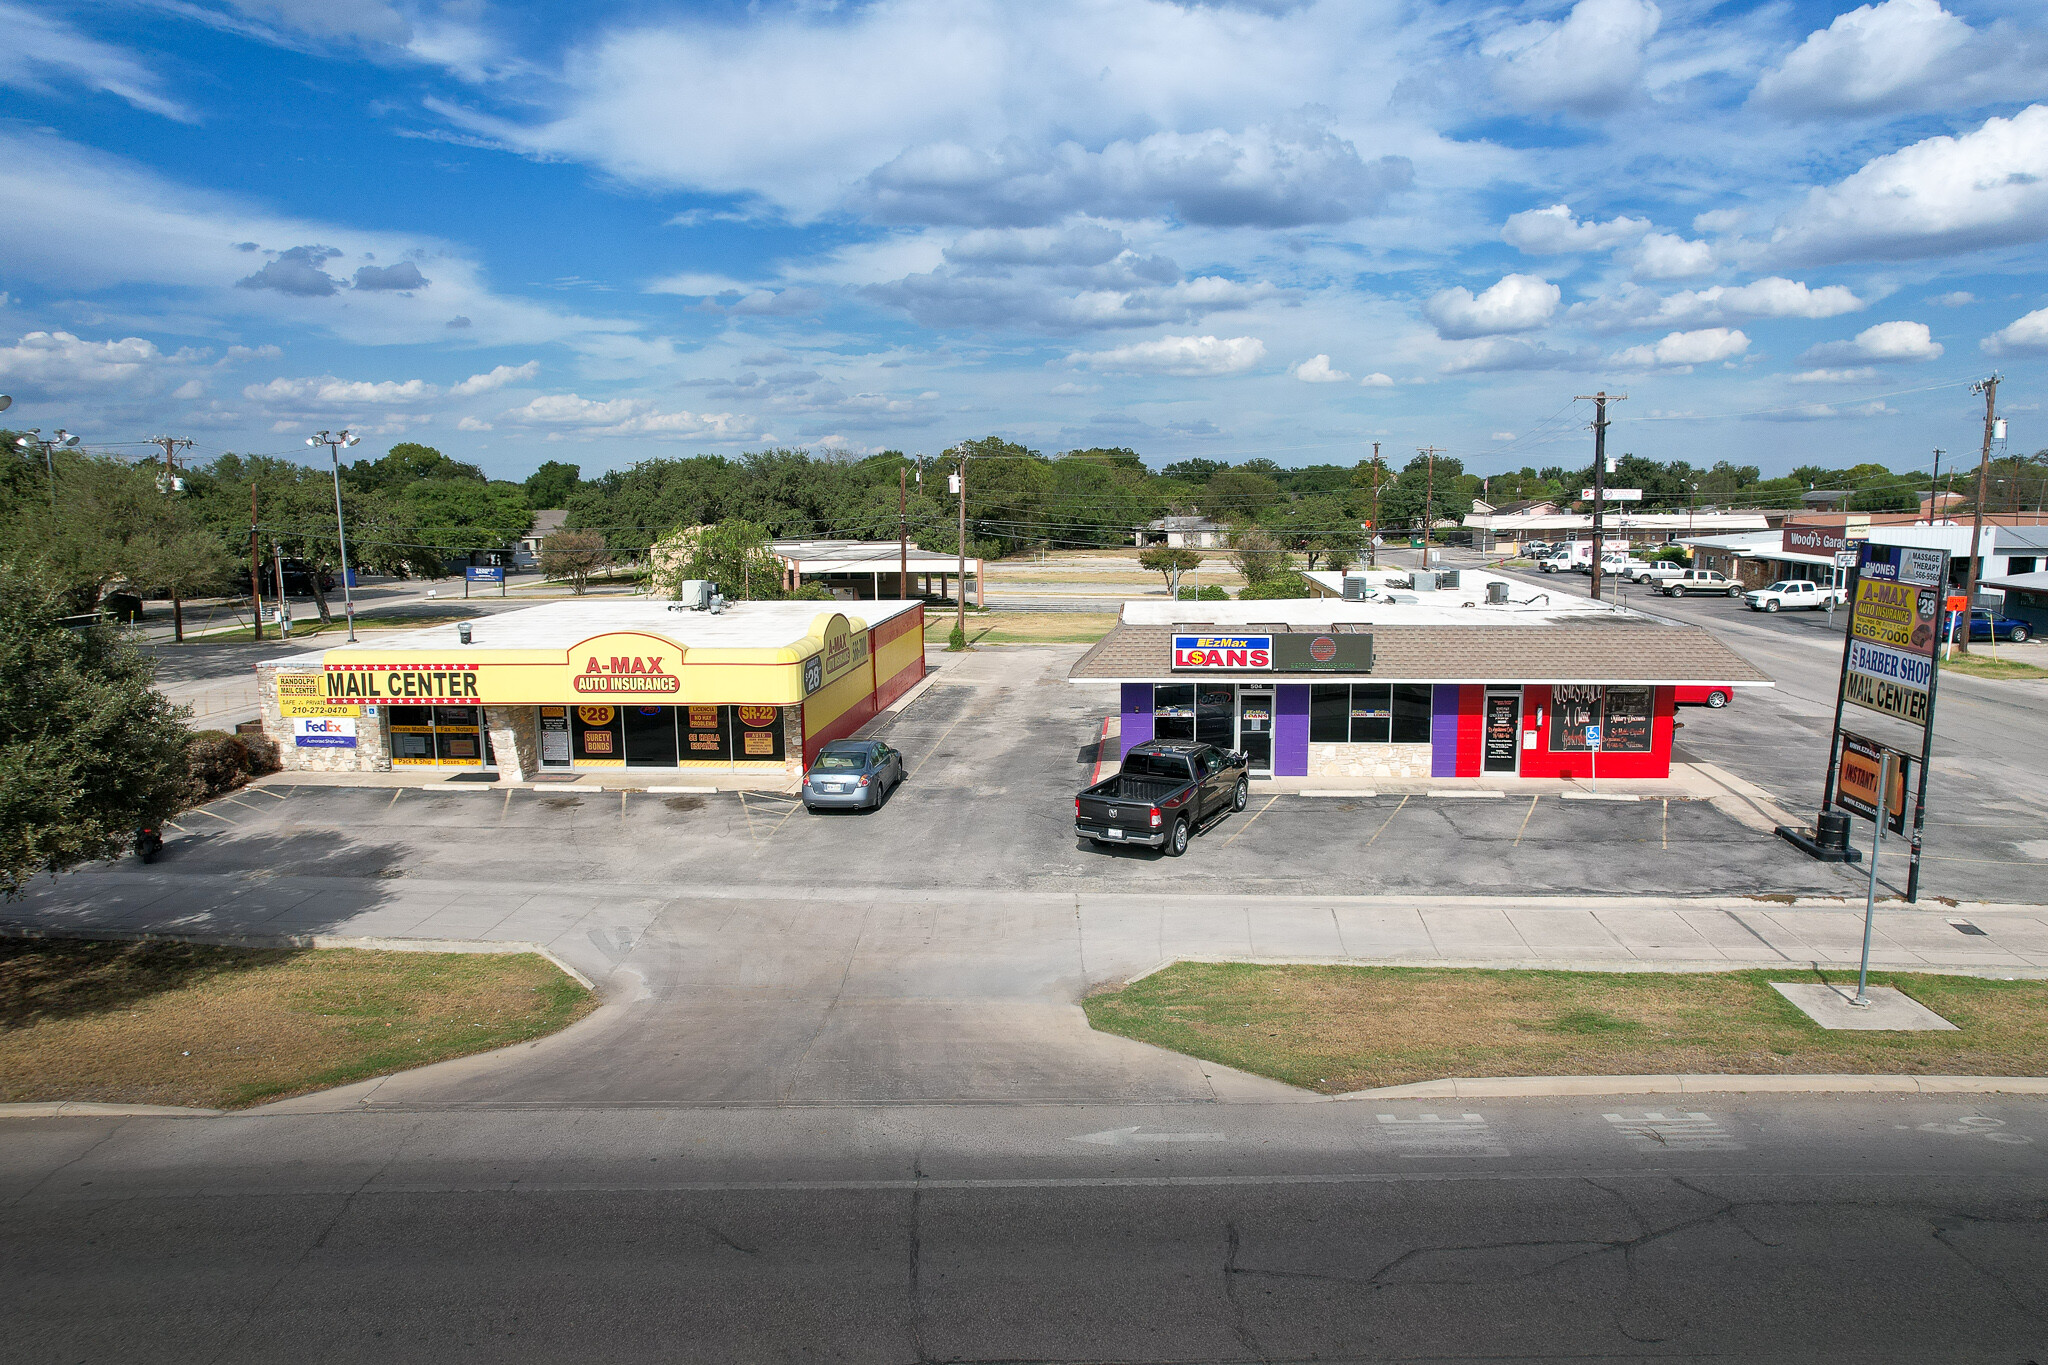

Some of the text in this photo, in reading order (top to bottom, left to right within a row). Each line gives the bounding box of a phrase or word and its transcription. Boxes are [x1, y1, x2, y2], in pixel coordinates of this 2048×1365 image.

[1791, 531, 1821, 548] Woody's
[1823, 536, 1846, 551] Garag
[1913, 552, 1940, 562] MASSAGE
[1865, 562, 1896, 576] PHONES
[1914, 562, 1940, 572] THERAPY
[1863, 582, 1910, 607] A-MAX
[1858, 602, 1909, 623] AUTO INSURANCE
[1918, 598, 1935, 615] $28
[1855, 622, 1909, 644] 566-7000
[586, 656, 664, 674] A-MAX
[1859, 647, 1930, 685] BARBER SHOP
[327, 673, 478, 697] MAIL CENTER
[578, 677, 676, 690] AUTO INSURANCE
[1201, 694, 1228, 704] OPEN
[1847, 672, 1927, 721] MAIL CENTER
[292, 706, 348, 714] 210-272-0470
[581, 706, 609, 721] $28
[741, 707, 774, 720] SR-22
[306, 720, 342, 732] FedEx
[586, 733, 610, 742] SURETY
[689, 733, 721, 742] SE HABLA
[588, 742, 610, 751] BONDS
[1845, 763, 1876, 791] INSTANT
